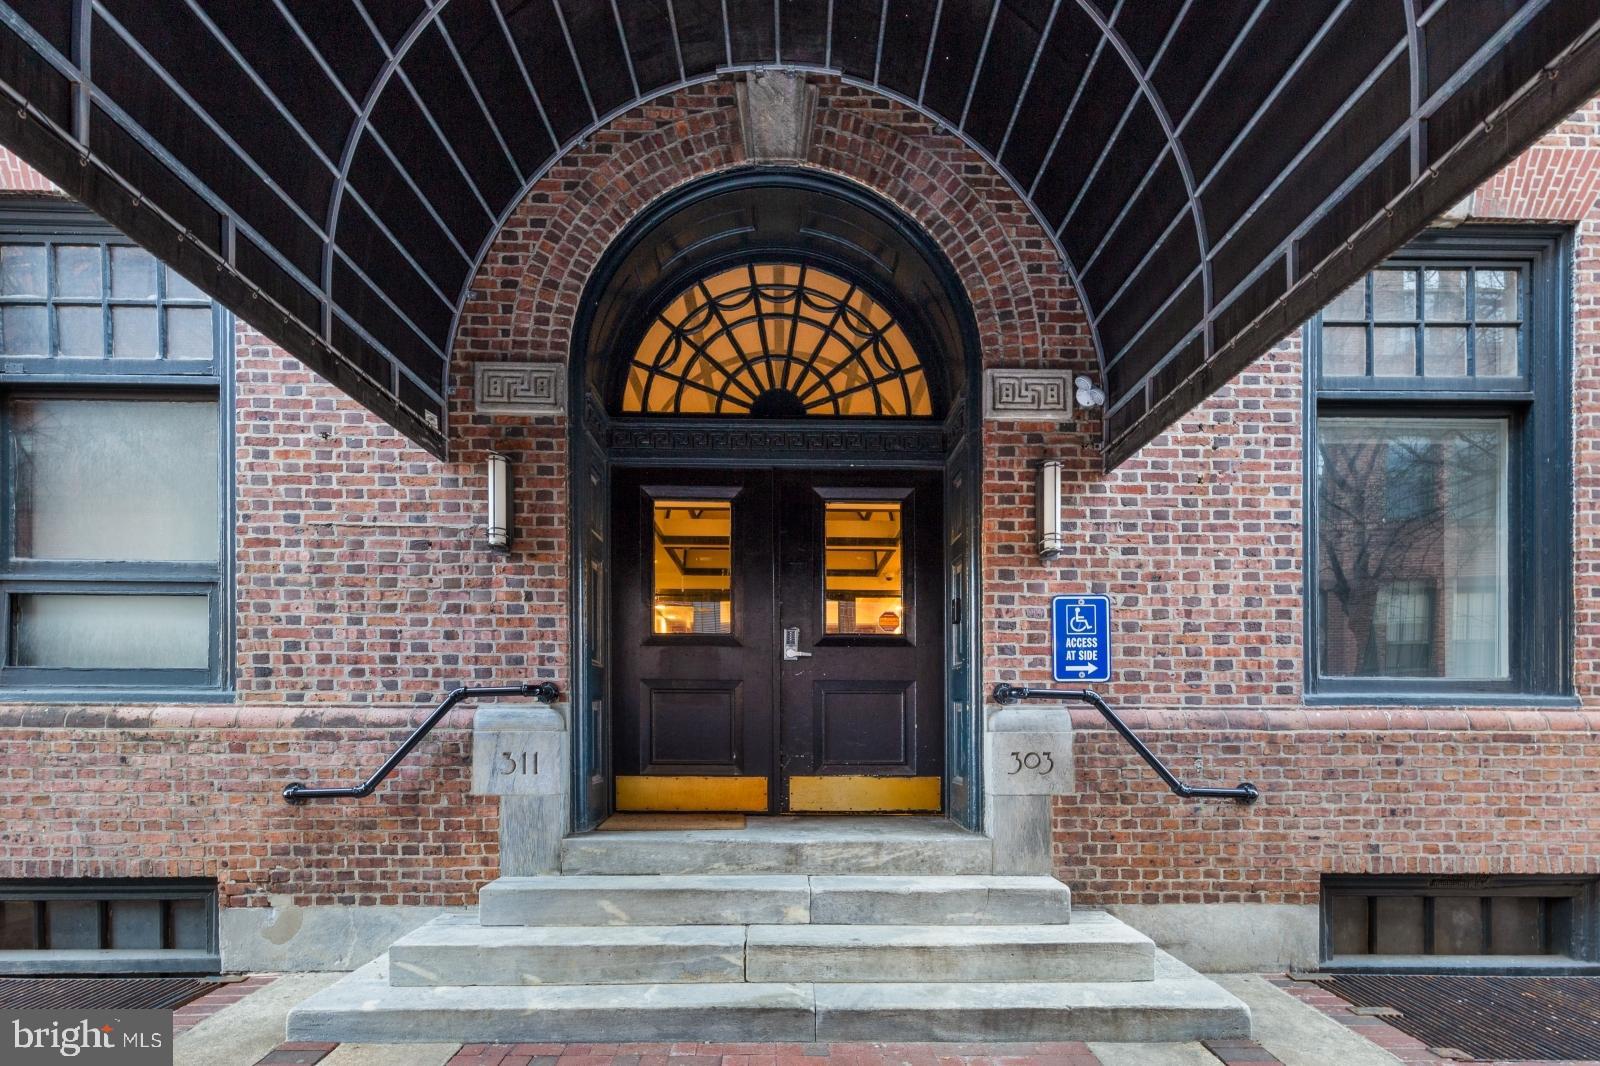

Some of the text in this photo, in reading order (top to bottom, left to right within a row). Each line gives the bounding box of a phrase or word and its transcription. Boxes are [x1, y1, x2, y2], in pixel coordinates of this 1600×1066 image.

[1066, 637, 1098, 648] ACCESS
[1066, 650, 1098, 661] AT SIDE
[501, 751, 538, 775] 311
[1007, 751, 1054, 775] 303
